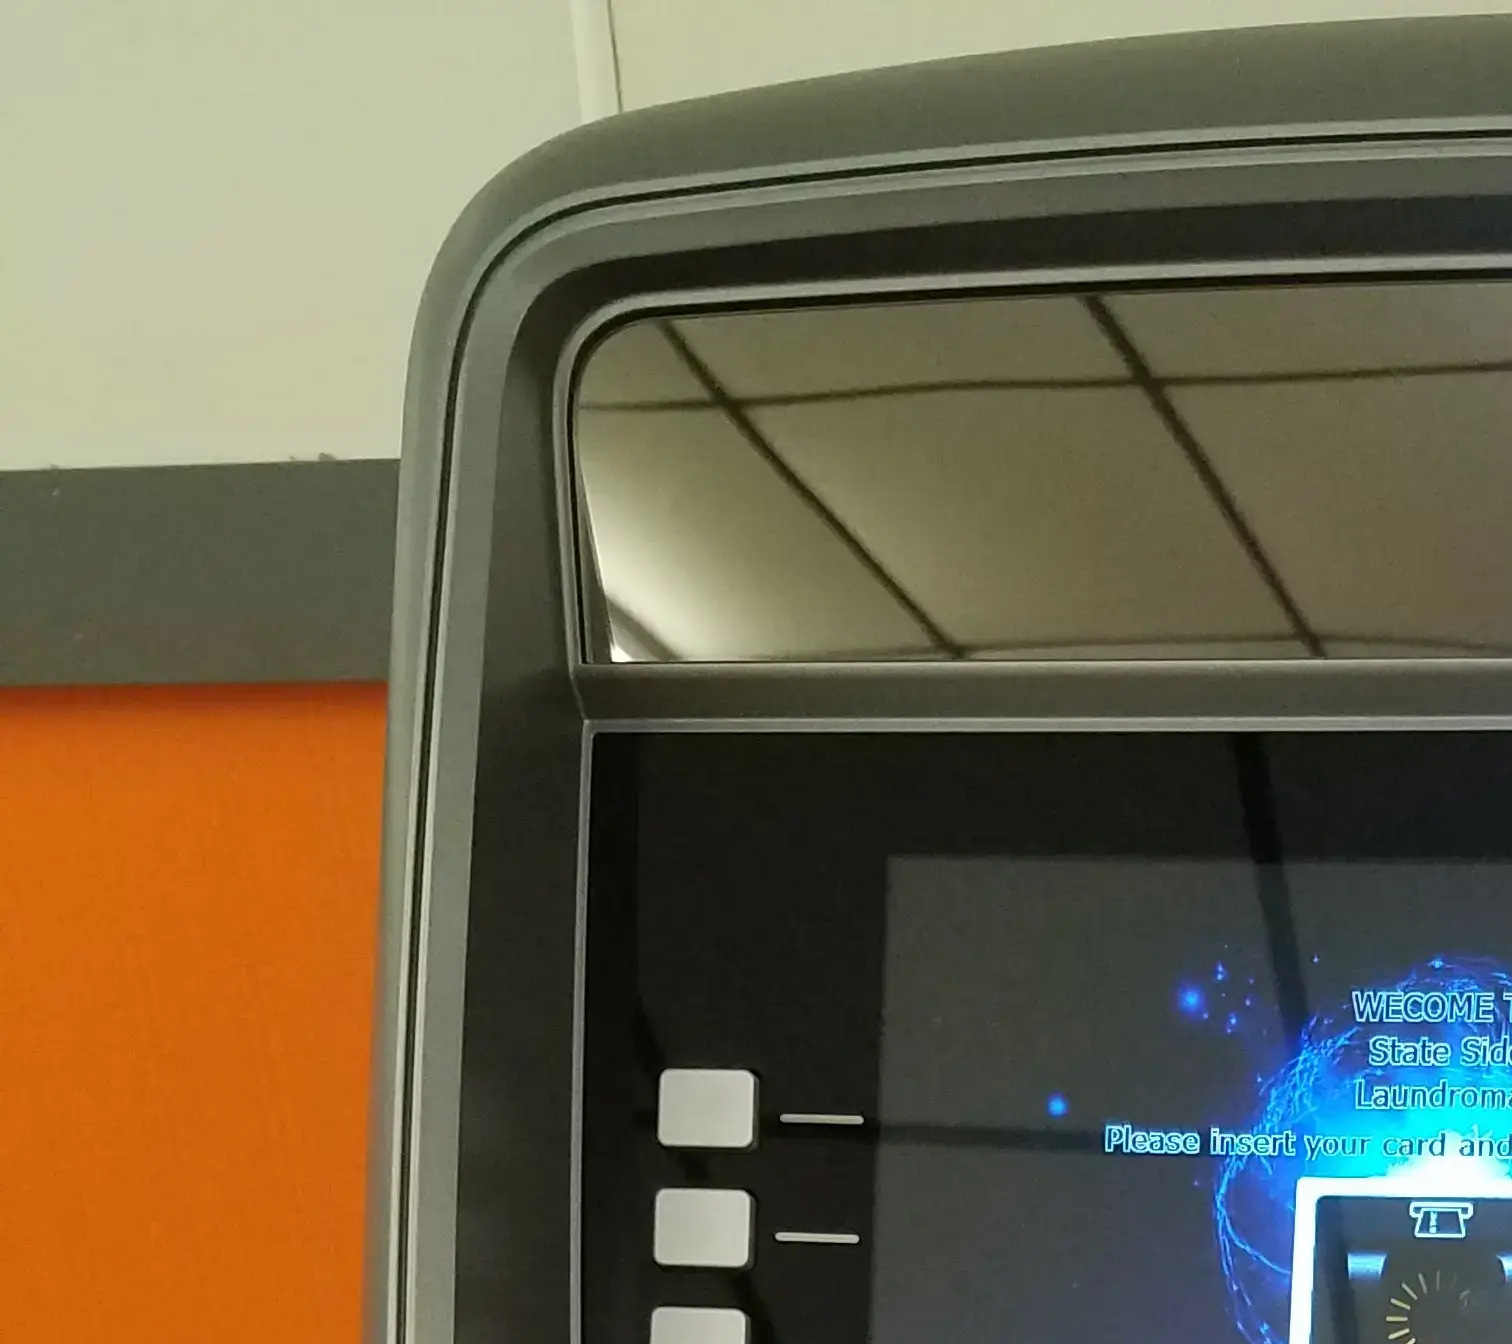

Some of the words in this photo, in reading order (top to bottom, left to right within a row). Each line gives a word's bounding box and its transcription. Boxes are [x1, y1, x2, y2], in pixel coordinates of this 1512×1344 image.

[1351, 990, 1495, 1023] WECOME
[1368, 1035, 1452, 1066] State
[1104, 1123, 1200, 1155] Please
[1209, 1127, 1296, 1156] insert
[1303, 1133, 1369, 1160] your
[1382, 1132, 1447, 1158] card
